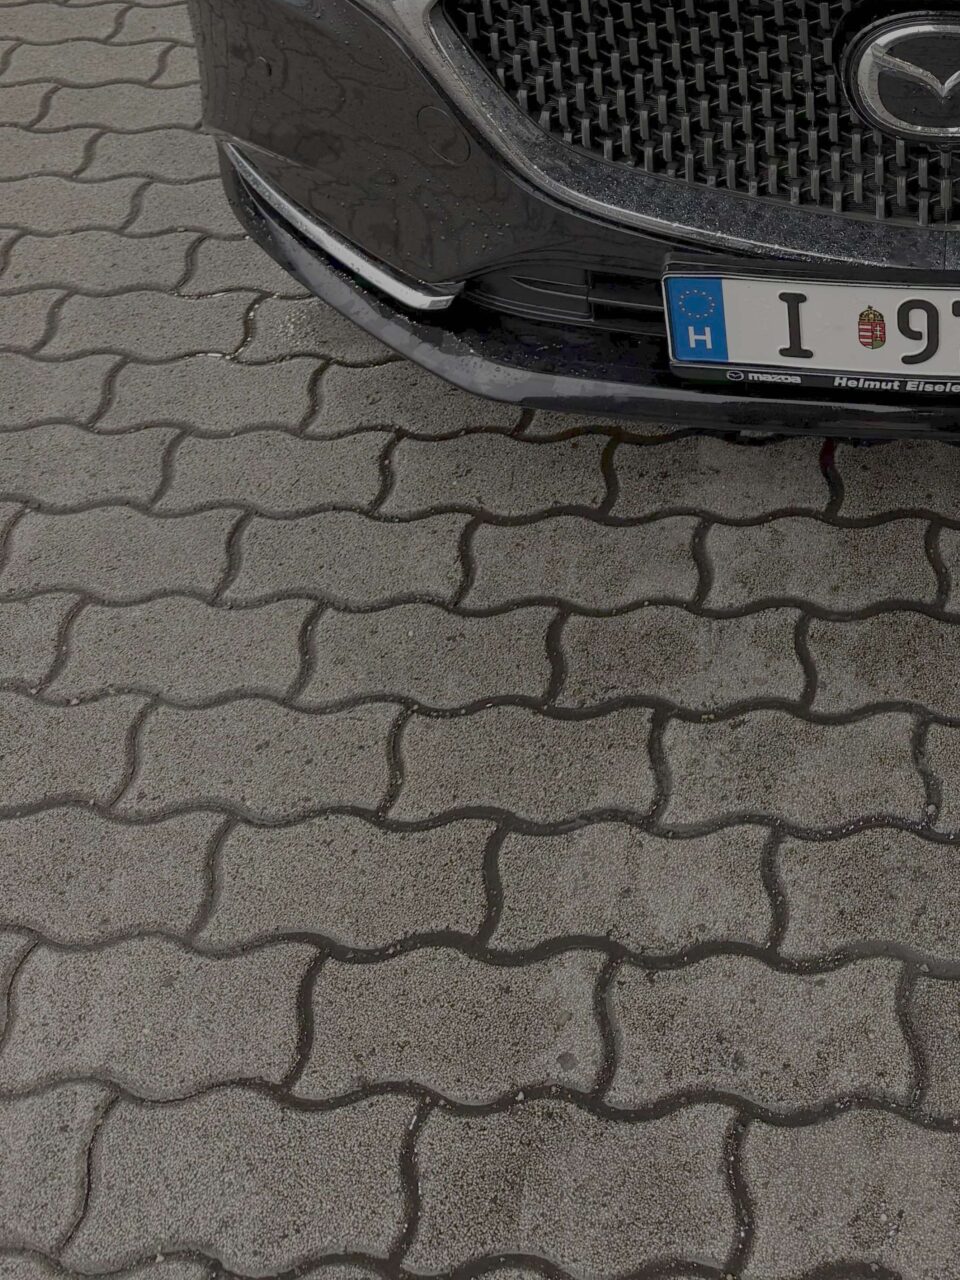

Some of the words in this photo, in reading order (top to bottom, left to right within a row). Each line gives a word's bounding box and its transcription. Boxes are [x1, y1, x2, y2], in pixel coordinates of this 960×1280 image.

[777, 291, 814, 359] I
[687, 325, 713, 350] H
[748, 372, 802, 384] mazda
[833, 376, 901, 391] Helmut
